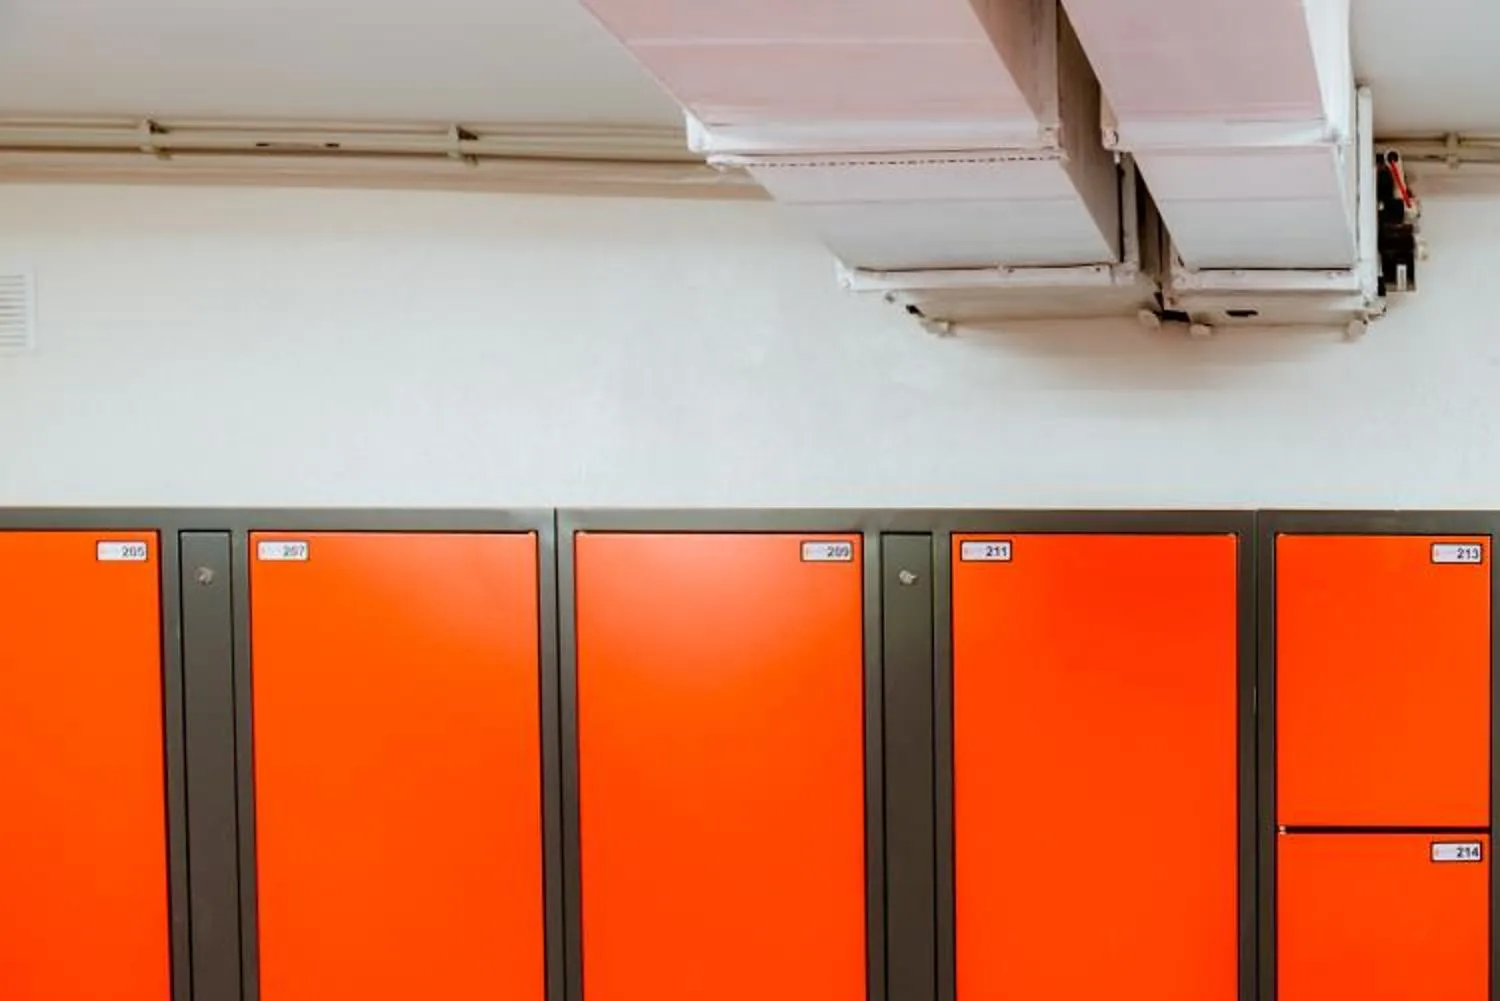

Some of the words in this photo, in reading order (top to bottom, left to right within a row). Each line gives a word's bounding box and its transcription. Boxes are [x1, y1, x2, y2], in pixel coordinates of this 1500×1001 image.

[122, 545, 145, 556] 205
[283, 546, 304, 556] 207
[827, 546, 849, 556] 209
[986, 546, 1008, 556] 211
[1456, 548, 1479, 559] 213
[1456, 847, 1479, 858] 214
